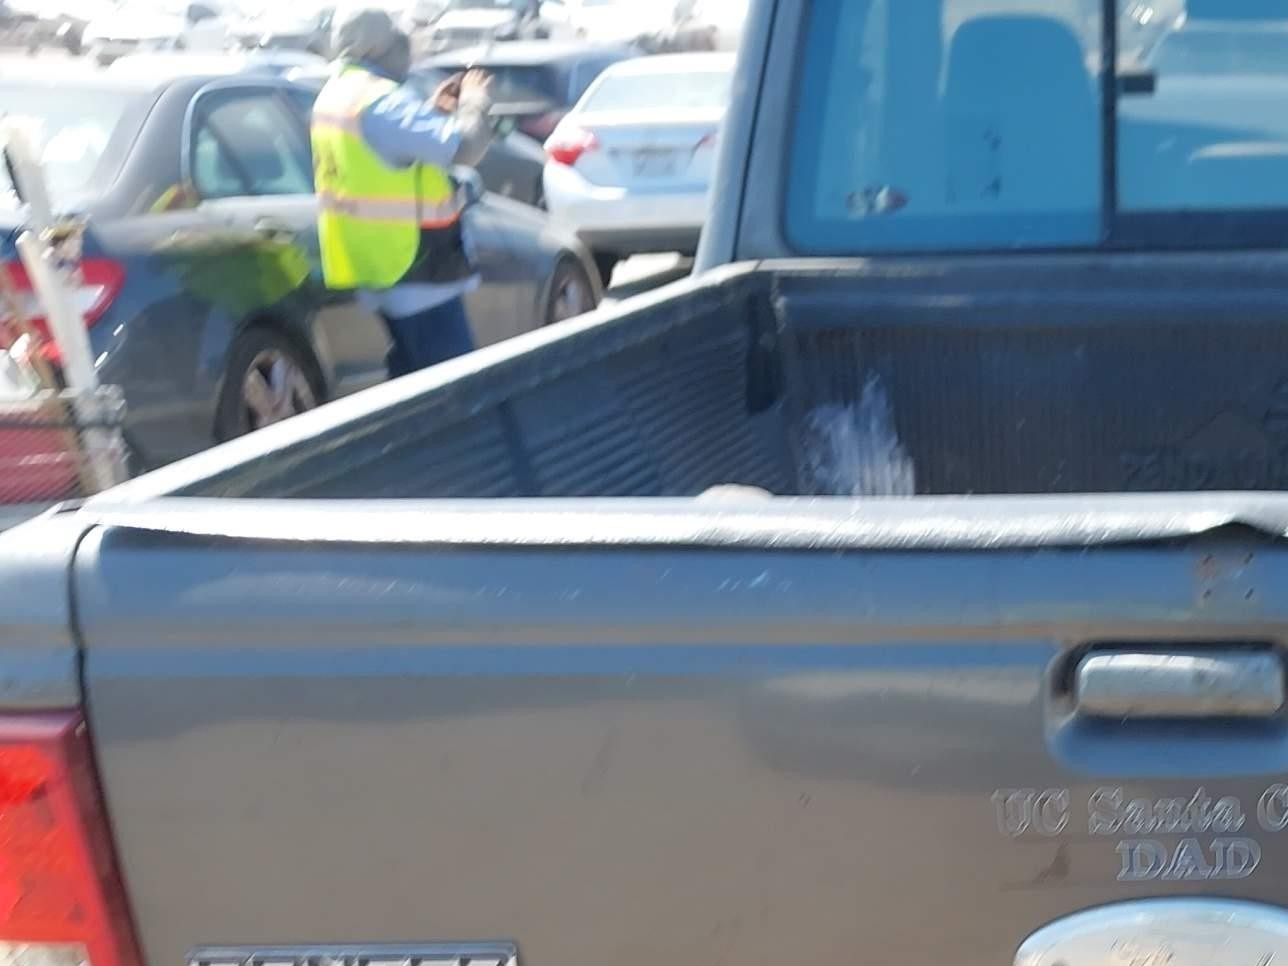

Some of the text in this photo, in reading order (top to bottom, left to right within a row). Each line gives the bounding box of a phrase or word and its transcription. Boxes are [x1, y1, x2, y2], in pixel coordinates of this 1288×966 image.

[992, 788, 1071, 836] UC
[1087, 786, 1246, 835] Santa
[1115, 837, 1262, 881] DAD
